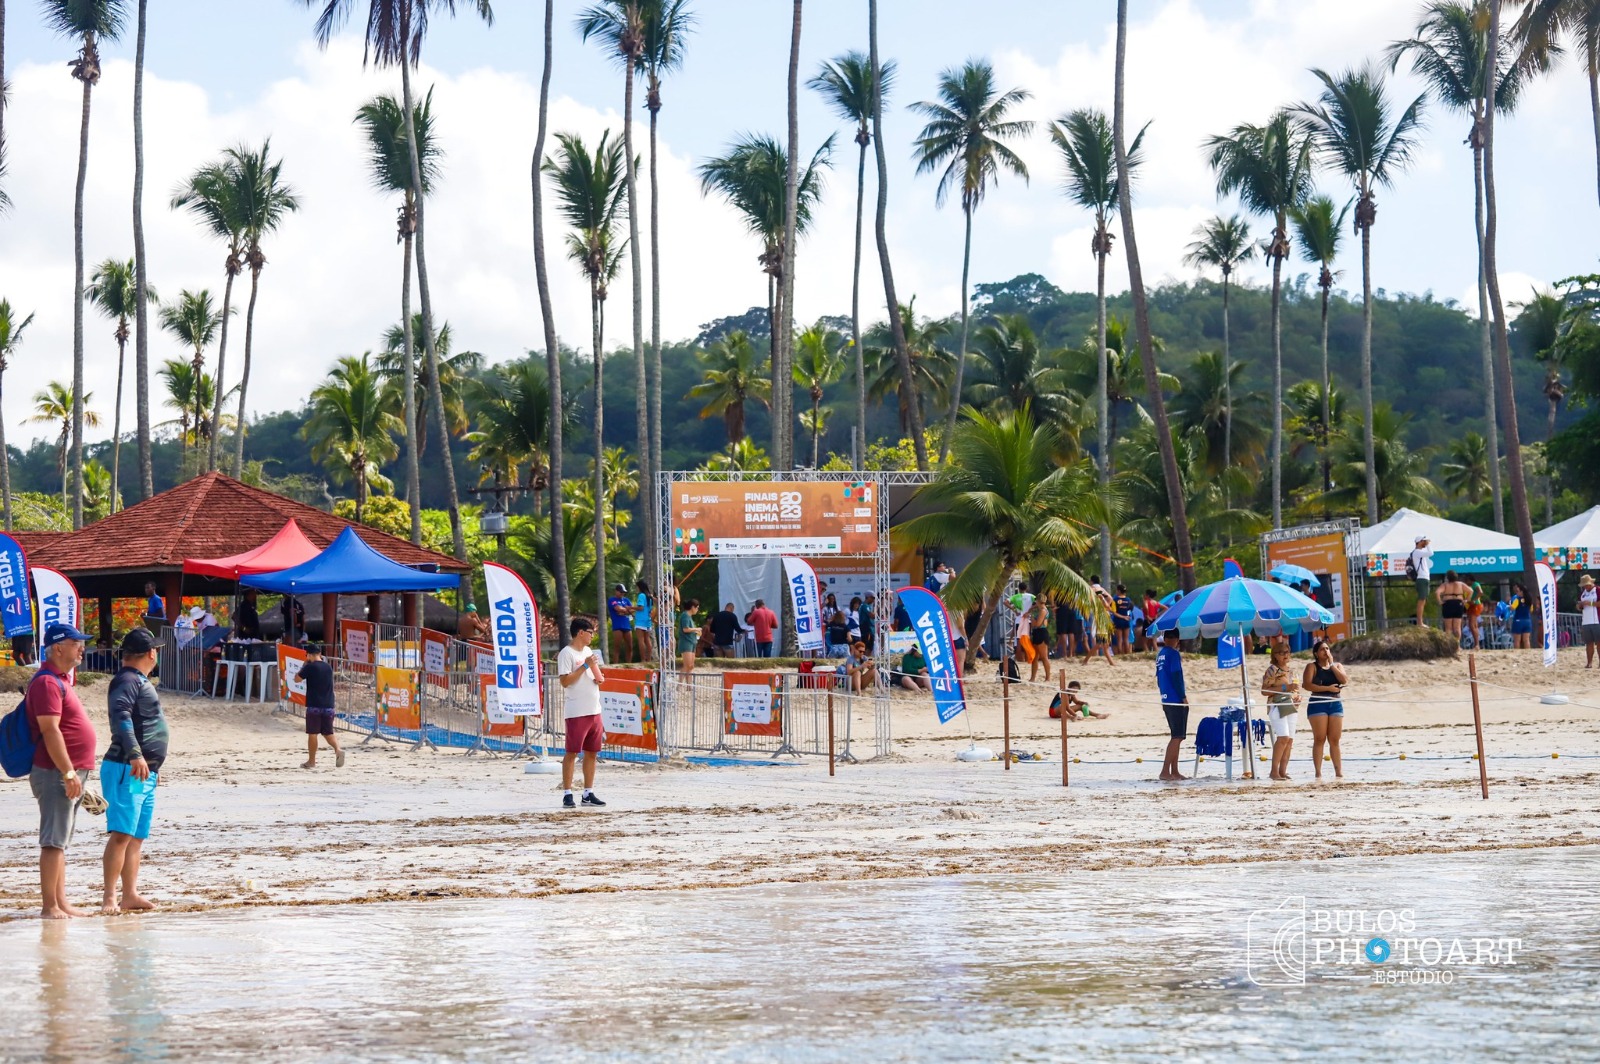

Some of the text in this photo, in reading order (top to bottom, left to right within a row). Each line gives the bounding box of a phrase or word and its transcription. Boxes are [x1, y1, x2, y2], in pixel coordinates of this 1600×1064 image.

[744, 492, 778, 502] FINAIS
[744, 503, 779, 512] INEMA
[779, 491, 802, 505] 20
[779, 504, 802, 518] 23
[744, 513, 779, 522] BAHIA
[0, 550, 16, 599] FBDA
[1449, 555, 1518, 567] ESPAÇO TIS
[67, 595, 75, 625] AMPEÕES
[792, 573, 808, 616] FBDA
[43, 591, 61, 633] BDA
[494, 596, 518, 662] FBDA
[523, 602, 533, 644] CAMPEÕES
[917, 610, 944, 674] FBDA
[936, 610, 951, 649] CAMPEÕES
